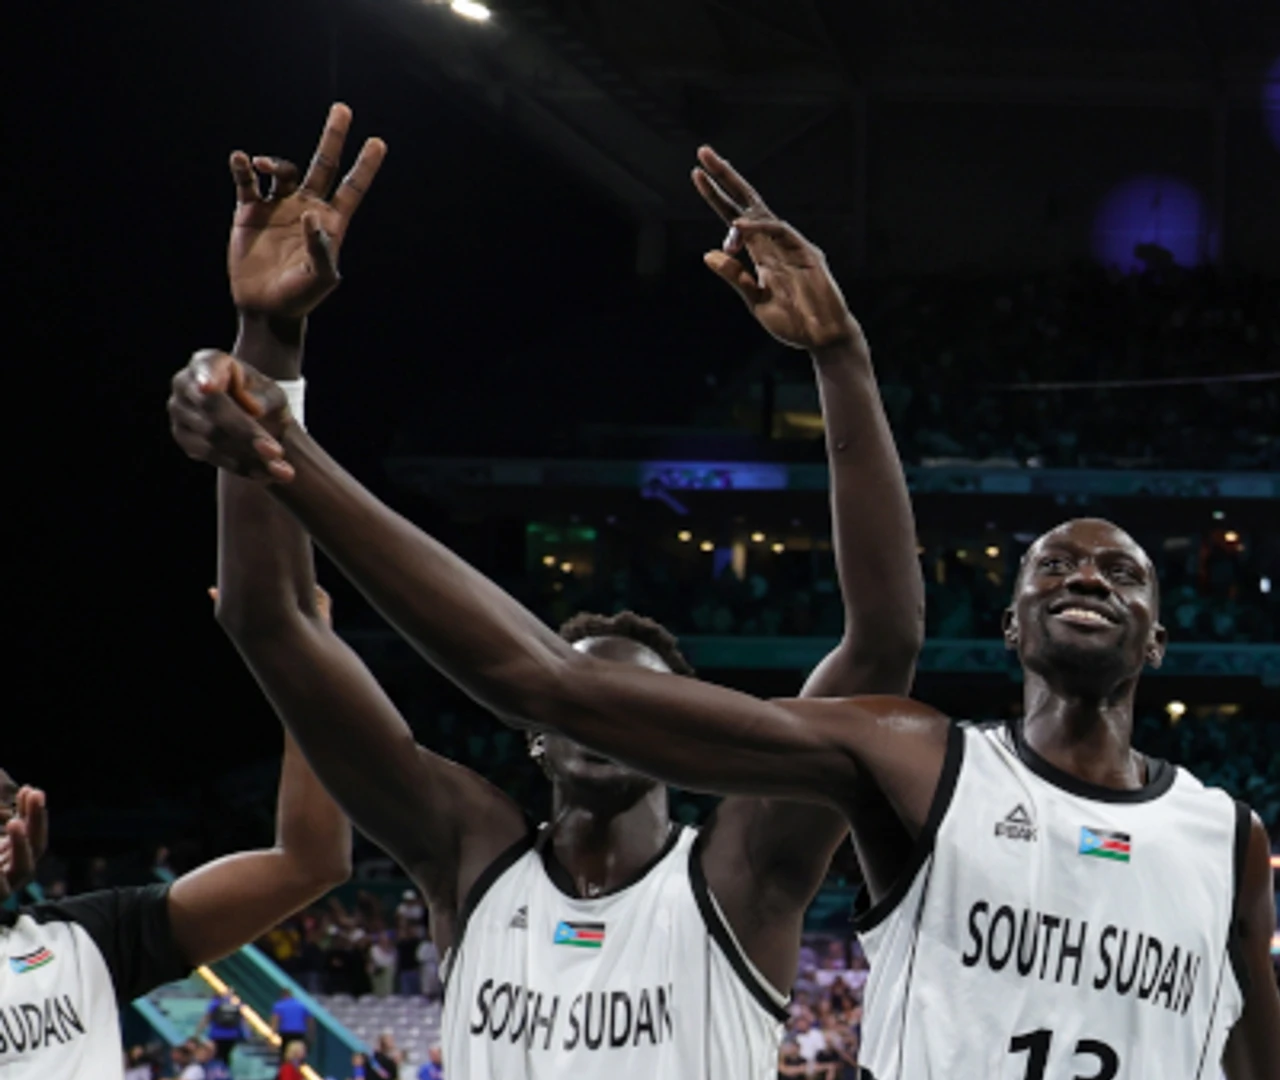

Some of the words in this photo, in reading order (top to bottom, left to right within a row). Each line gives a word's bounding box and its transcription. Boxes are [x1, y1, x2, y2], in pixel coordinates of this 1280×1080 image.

[962, 900, 1088, 985] SOUTH
[1093, 924, 1201, 1017] SUDAN
[564, 982, 673, 1051] SUDAN
